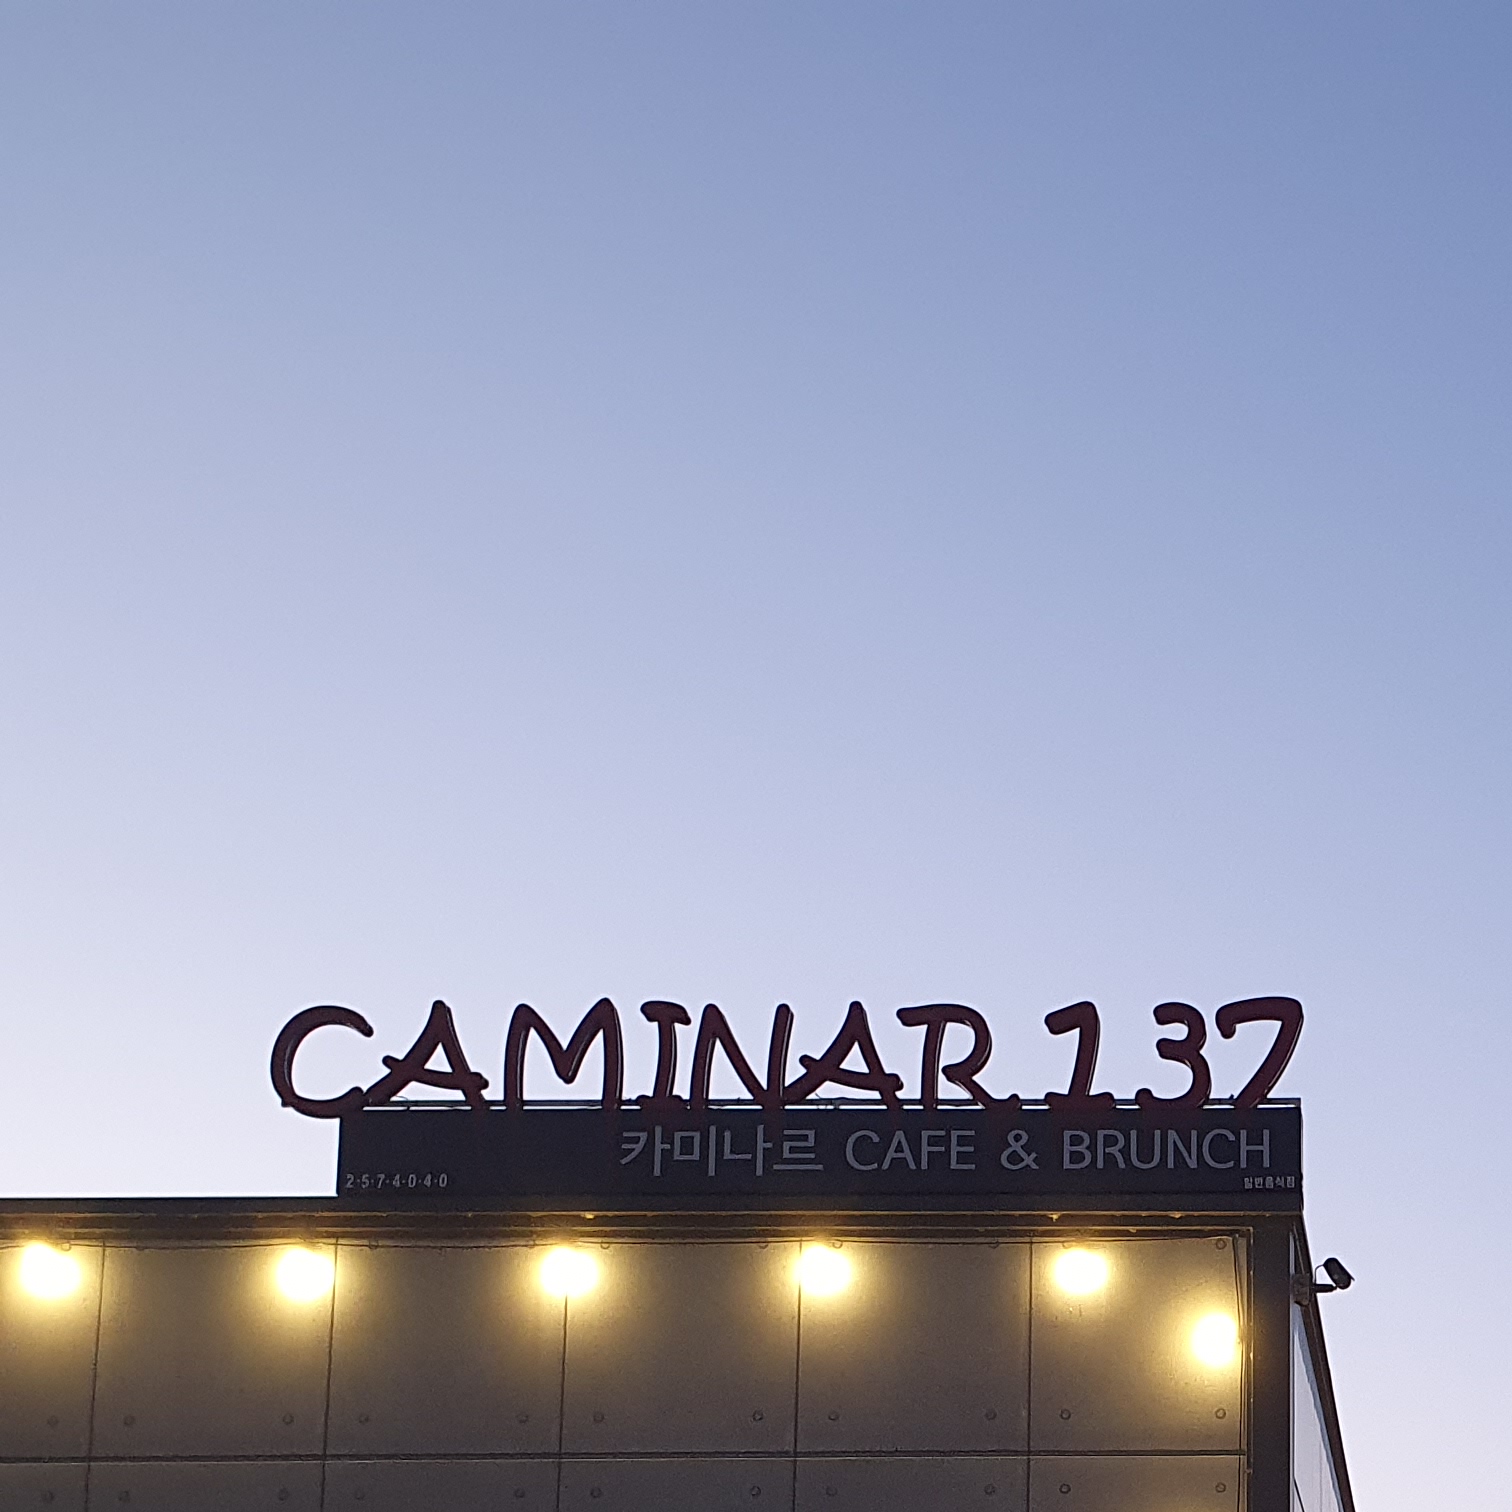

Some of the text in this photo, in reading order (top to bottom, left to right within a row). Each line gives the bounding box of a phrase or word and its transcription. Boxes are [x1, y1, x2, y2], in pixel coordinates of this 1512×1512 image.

[270, 996, 1305, 1119] CAMINAR 137
[619, 1124, 1272, 1177] 카미나르 CAFE & BRUNCH
